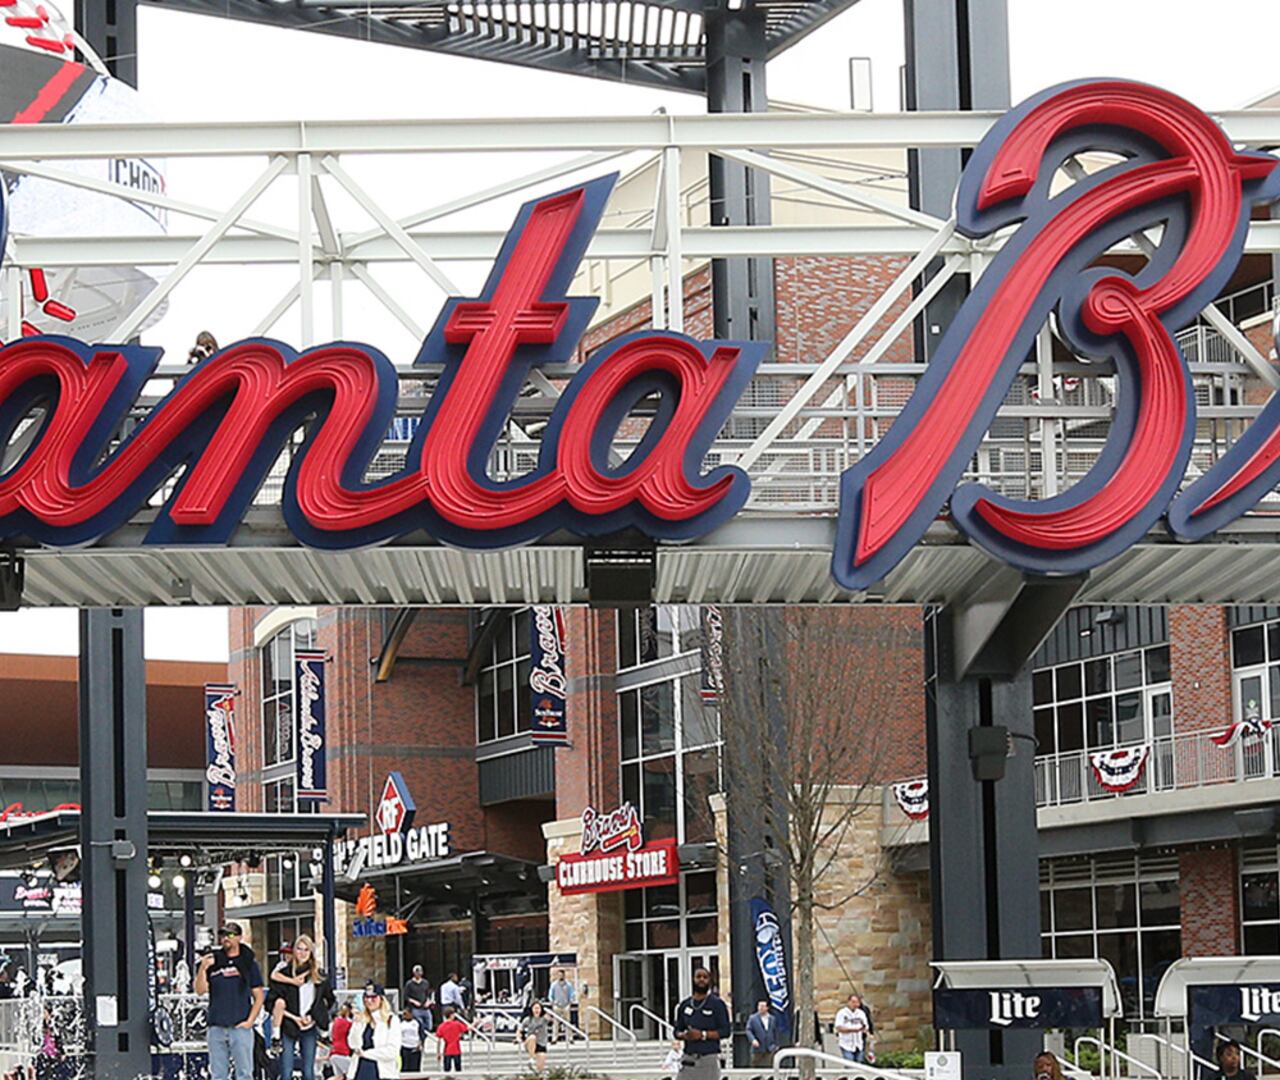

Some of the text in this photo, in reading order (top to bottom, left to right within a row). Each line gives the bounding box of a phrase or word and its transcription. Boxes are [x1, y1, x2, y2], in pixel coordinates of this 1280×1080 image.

[381, 797, 401, 831] RF
[581, 802, 632, 856] Braves
[406, 822, 449, 862] GATE
[558, 849, 668, 887] CLUBHOUSE STORE
[989, 991, 1041, 1026] Lite
